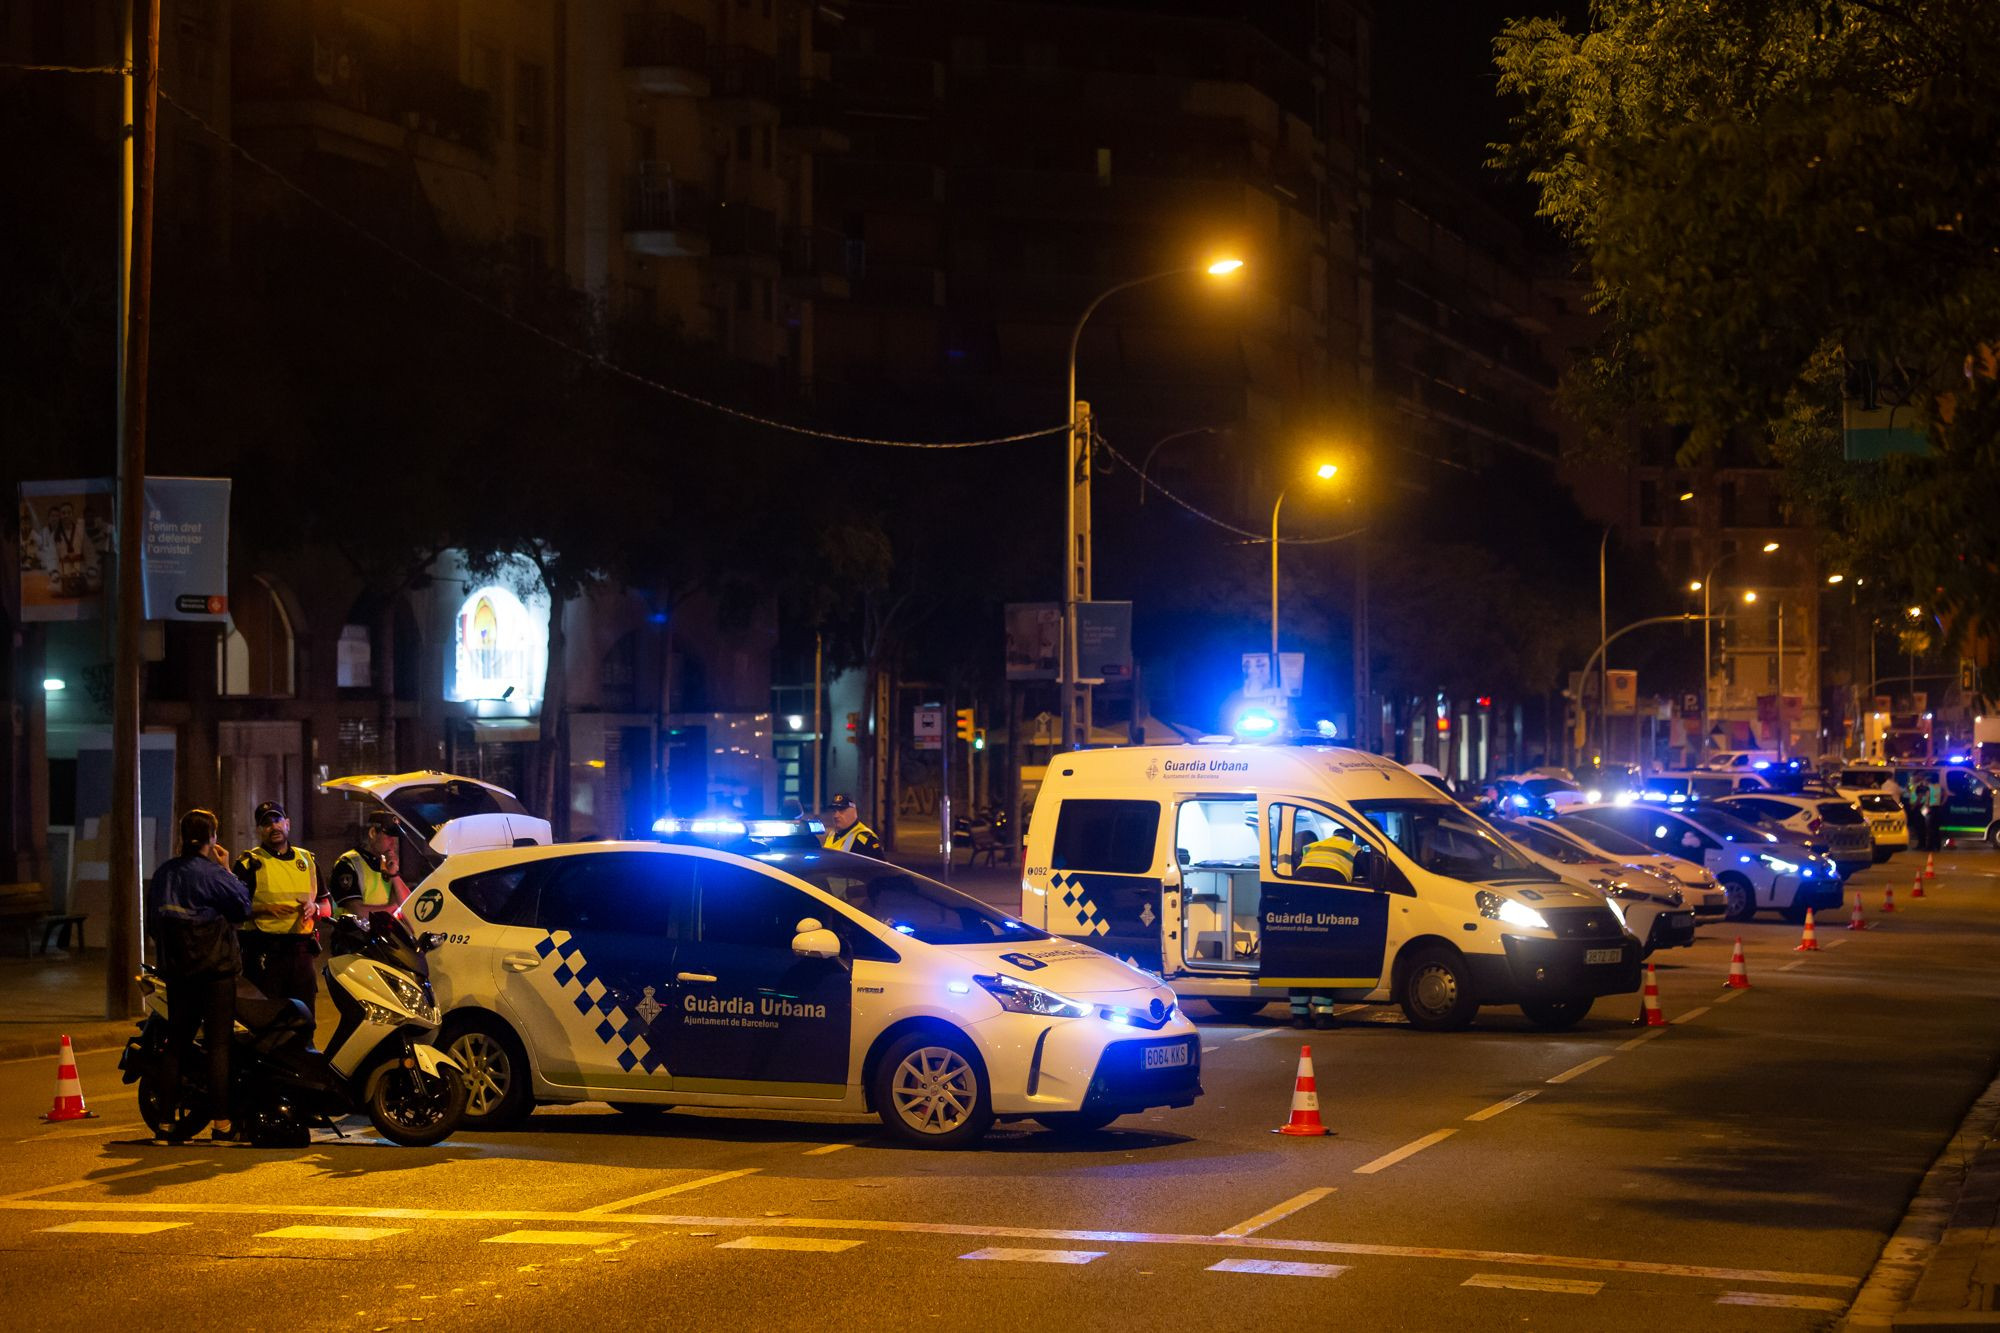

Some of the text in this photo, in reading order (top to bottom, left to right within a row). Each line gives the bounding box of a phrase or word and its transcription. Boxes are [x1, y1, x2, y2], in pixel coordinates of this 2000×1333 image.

[1164, 760, 1249, 771] Guardia Urbana
[1033, 866, 1048, 876] 092
[1317, 913, 1360, 926] Urbana
[450, 934, 470, 944] 092
[684, 994, 826, 1018] Guàrdia Urbana
[684, 1015, 779, 1029] Ajuntament de Barcelona
[1147, 1046, 1186, 1066] 6064 KKS
